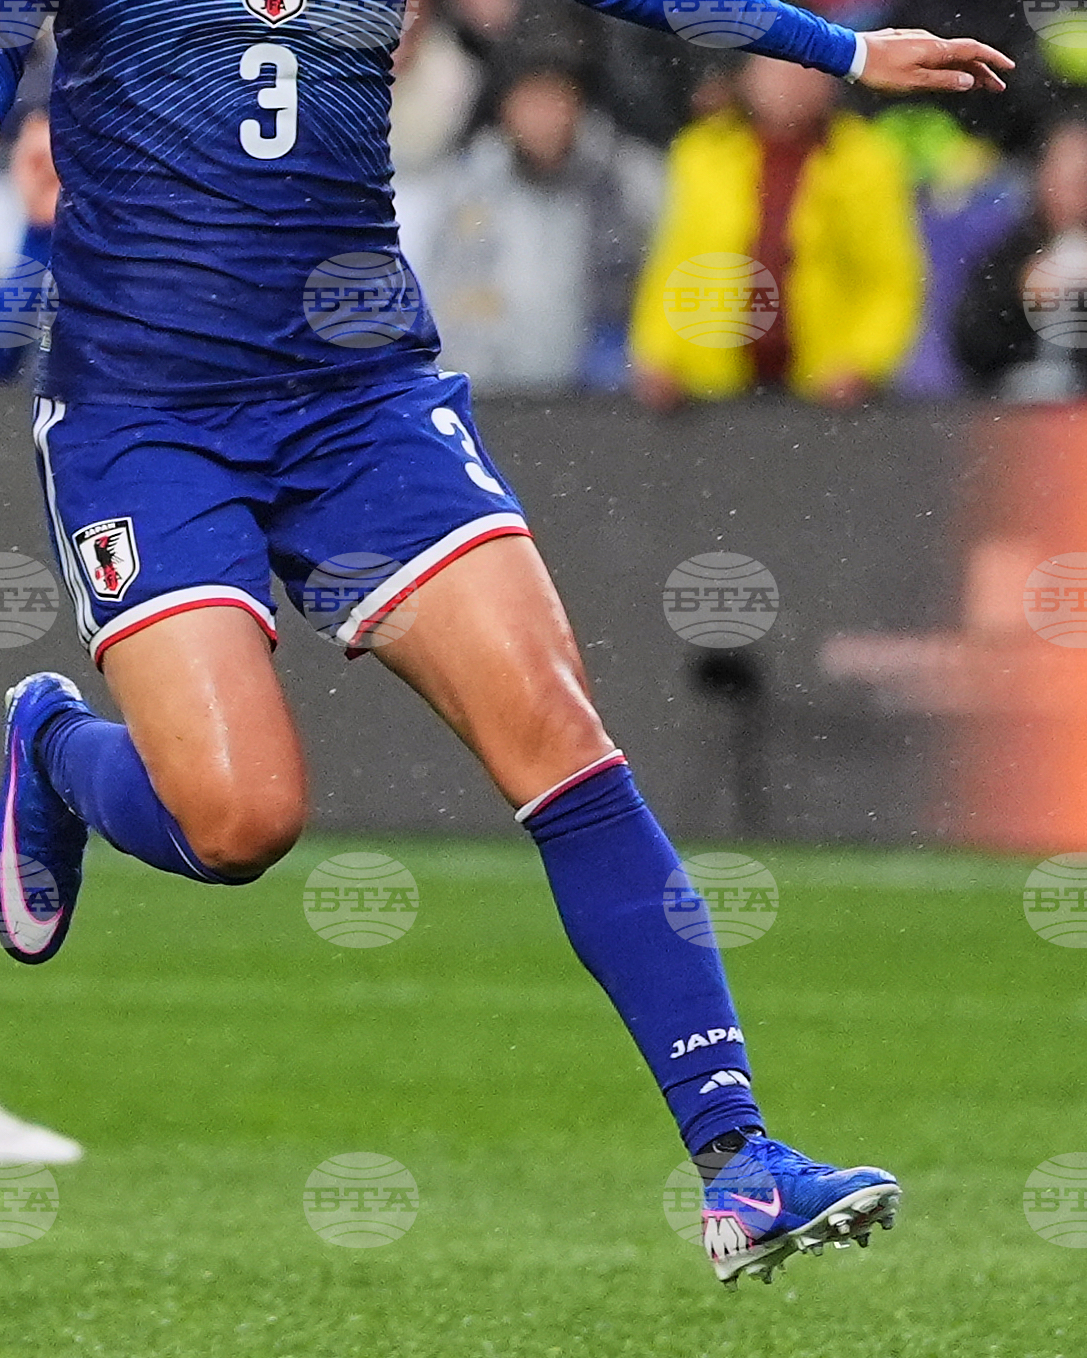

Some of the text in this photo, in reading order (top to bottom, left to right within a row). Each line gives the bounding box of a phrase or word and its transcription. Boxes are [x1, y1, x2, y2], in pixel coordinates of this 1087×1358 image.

[239, 43, 298, 159] 3
[430, 407, 506, 496] 3
[84, 522, 116, 539] JAPAN
[670, 1026, 745, 1059] JAPA
